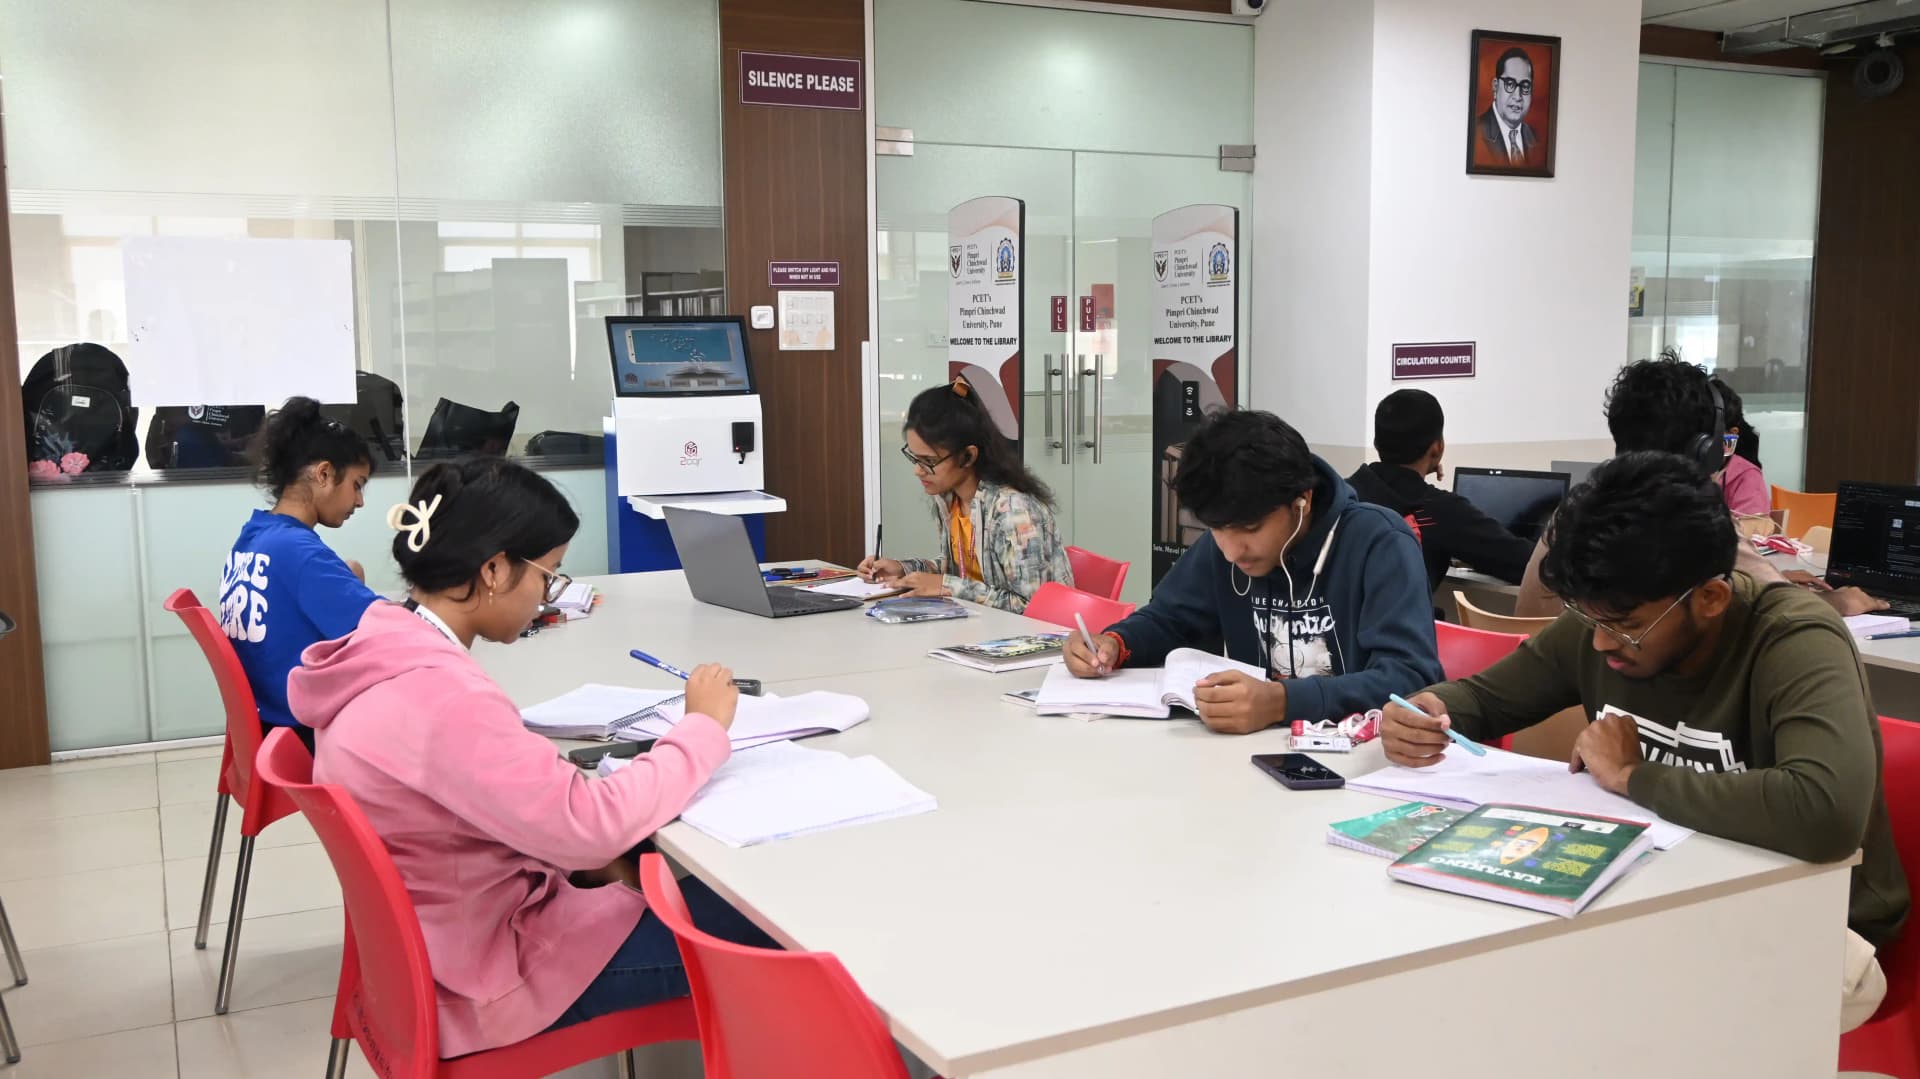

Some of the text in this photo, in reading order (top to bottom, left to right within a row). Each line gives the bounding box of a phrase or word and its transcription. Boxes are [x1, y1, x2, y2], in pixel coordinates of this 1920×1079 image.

[748, 70, 855, 93] SILENCE PLEASE
[1180, 295, 1203, 304] PCET's
[960, 305, 1006, 318] Pimpri Chinchwad
[1165, 305, 1219, 318] Pimpri Chinchwad
[990, 319, 1002, 328] Pune
[1200, 319, 1215, 328] Pune
[950, 337, 1017, 345] WELCOME TO THE LIBRARY
[1154, 334, 1232, 344] WELCOME TO THE LIBRARY
[1396, 355, 1471, 366] CIRCULATION COUNTER
